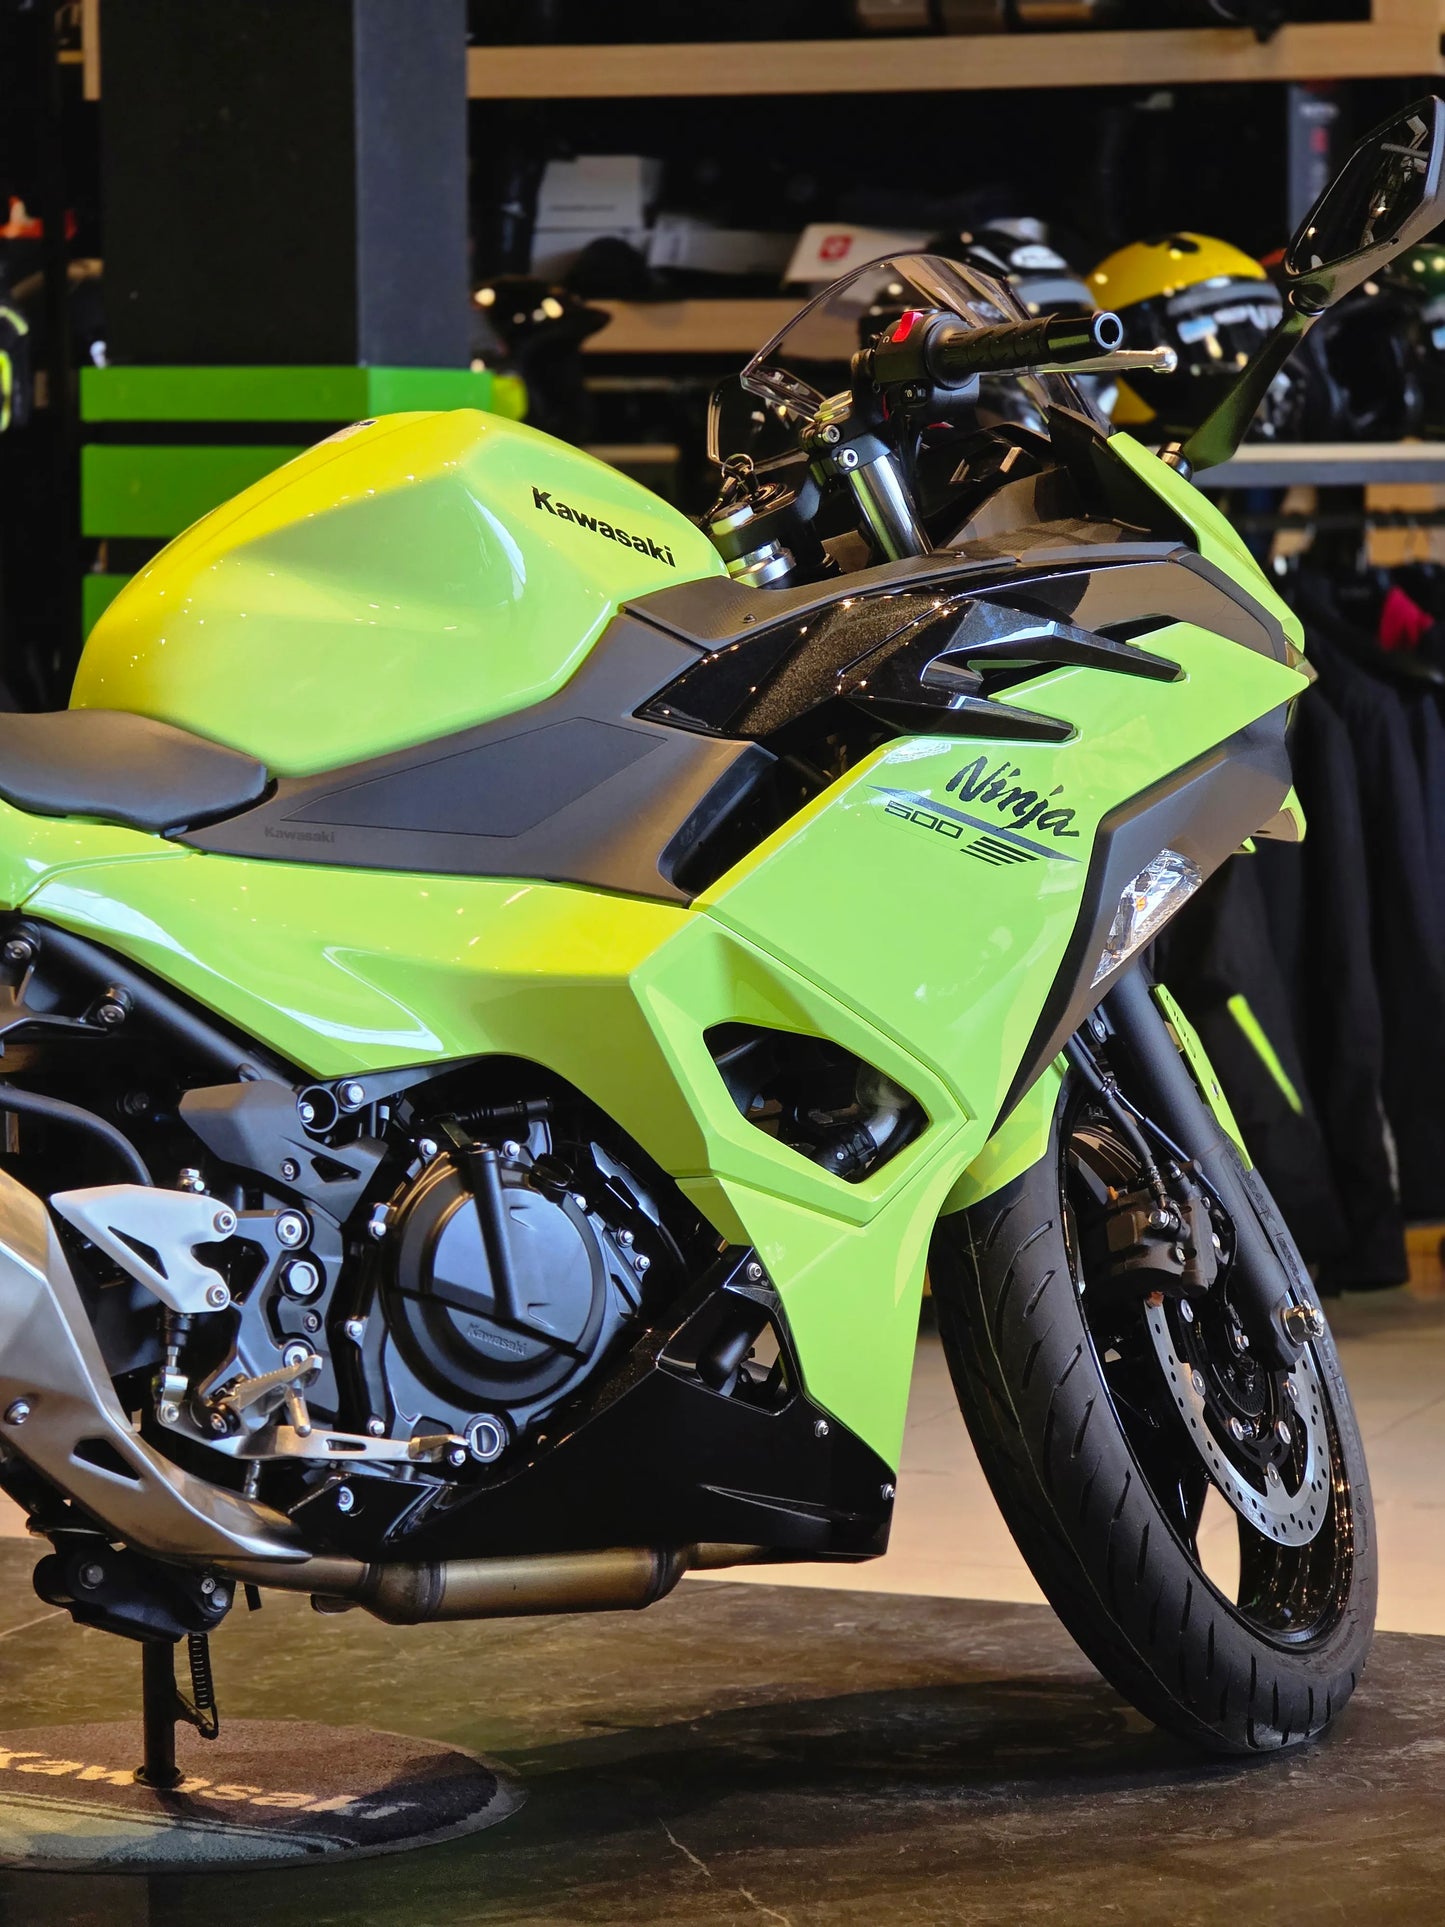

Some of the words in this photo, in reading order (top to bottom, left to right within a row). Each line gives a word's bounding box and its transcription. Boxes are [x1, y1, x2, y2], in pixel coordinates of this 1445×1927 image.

[531, 486, 676, 568] Kawasaki
[945, 756, 1080, 837] Ninja
[263, 826, 336, 843] Kawasaki
[884, 800, 963, 839] 500
[466, 1322, 527, 1356] Kawasaki
